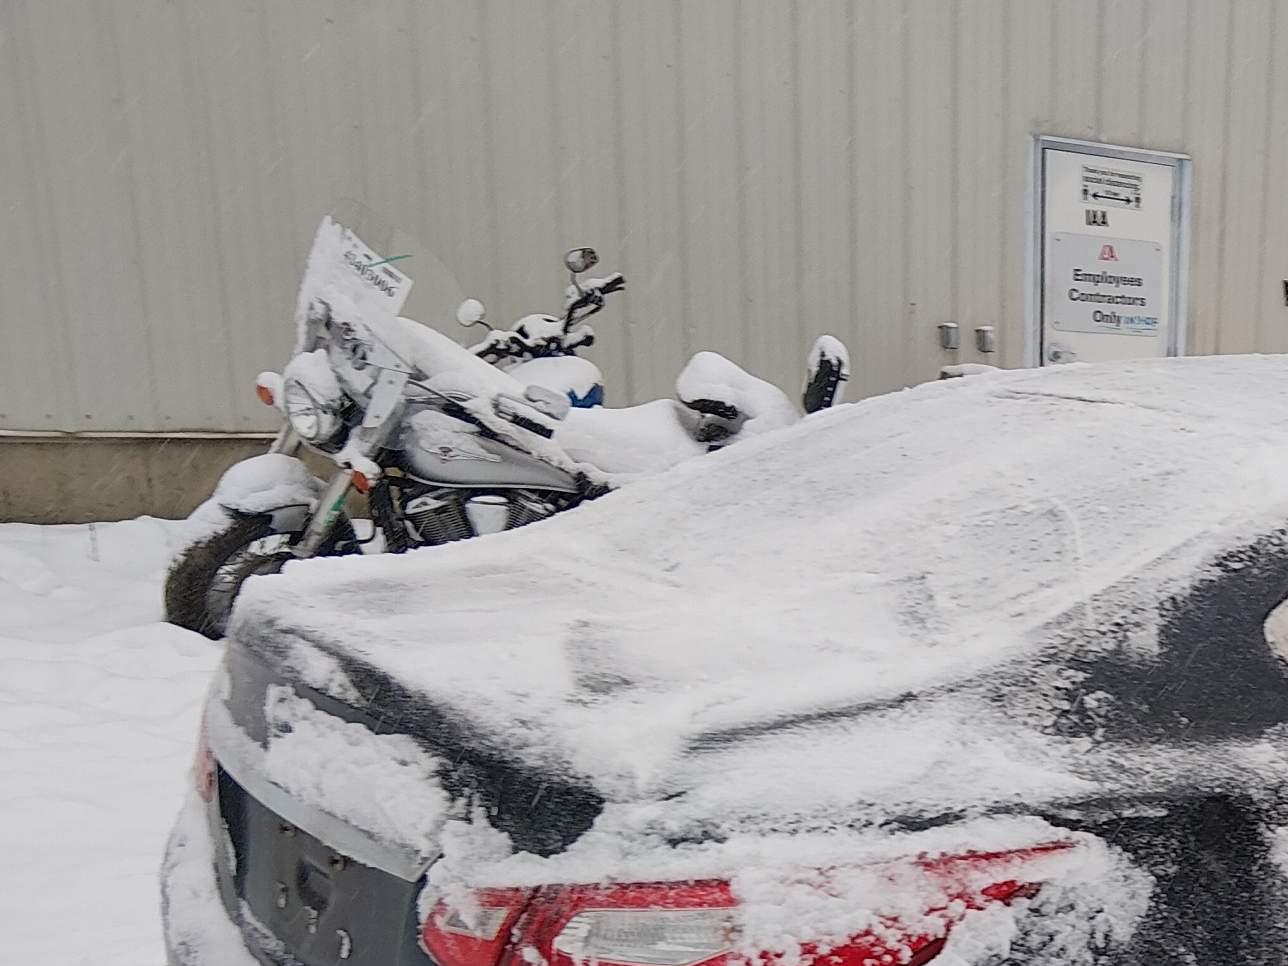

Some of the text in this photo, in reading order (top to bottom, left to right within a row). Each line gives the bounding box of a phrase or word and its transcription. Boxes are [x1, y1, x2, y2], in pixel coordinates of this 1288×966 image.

[1085, 209, 1110, 227] IAA
[1072, 268, 1144, 288] Employees
[1068, 288, 1147, 306] Contractors
[1092, 310, 1121, 327] Only
